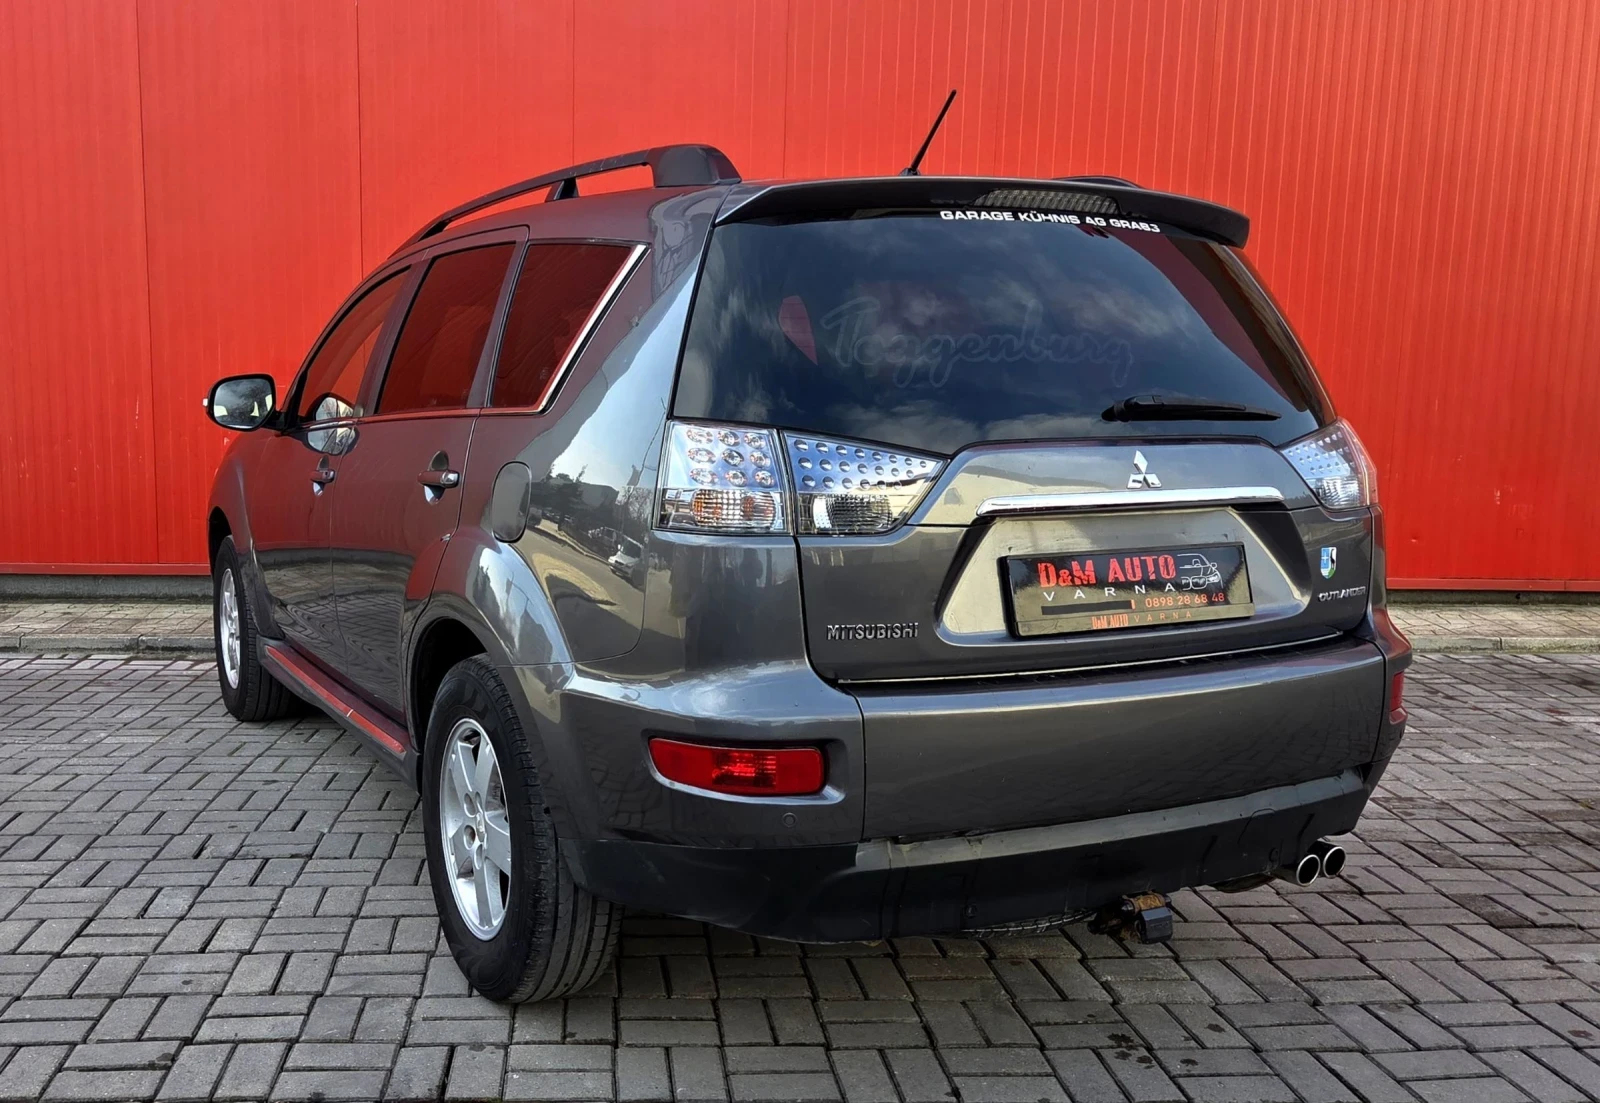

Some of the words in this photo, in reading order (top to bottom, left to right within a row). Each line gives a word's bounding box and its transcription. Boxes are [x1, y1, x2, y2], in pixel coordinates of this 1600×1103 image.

[940, 210, 1015, 221] GARAGE
[1017, 210, 1081, 225] KÜHNIS
[1085, 216, 1107, 227] AG
[821, 297, 1133, 388] Toggenburg
[1037, 559, 1097, 588] D&M
[1107, 554, 1176, 583] AUTO
[1145, 597, 1174, 608] 0898
[1177, 595, 1191, 605] 28
[1194, 594, 1208, 603] 68
[1211, 592, 1225, 602] 48
[1318, 586, 1366, 602] OUTLANDER
[1109, 613, 1130, 628] AUTO
[826, 622, 919, 641] MITSUBISHI
